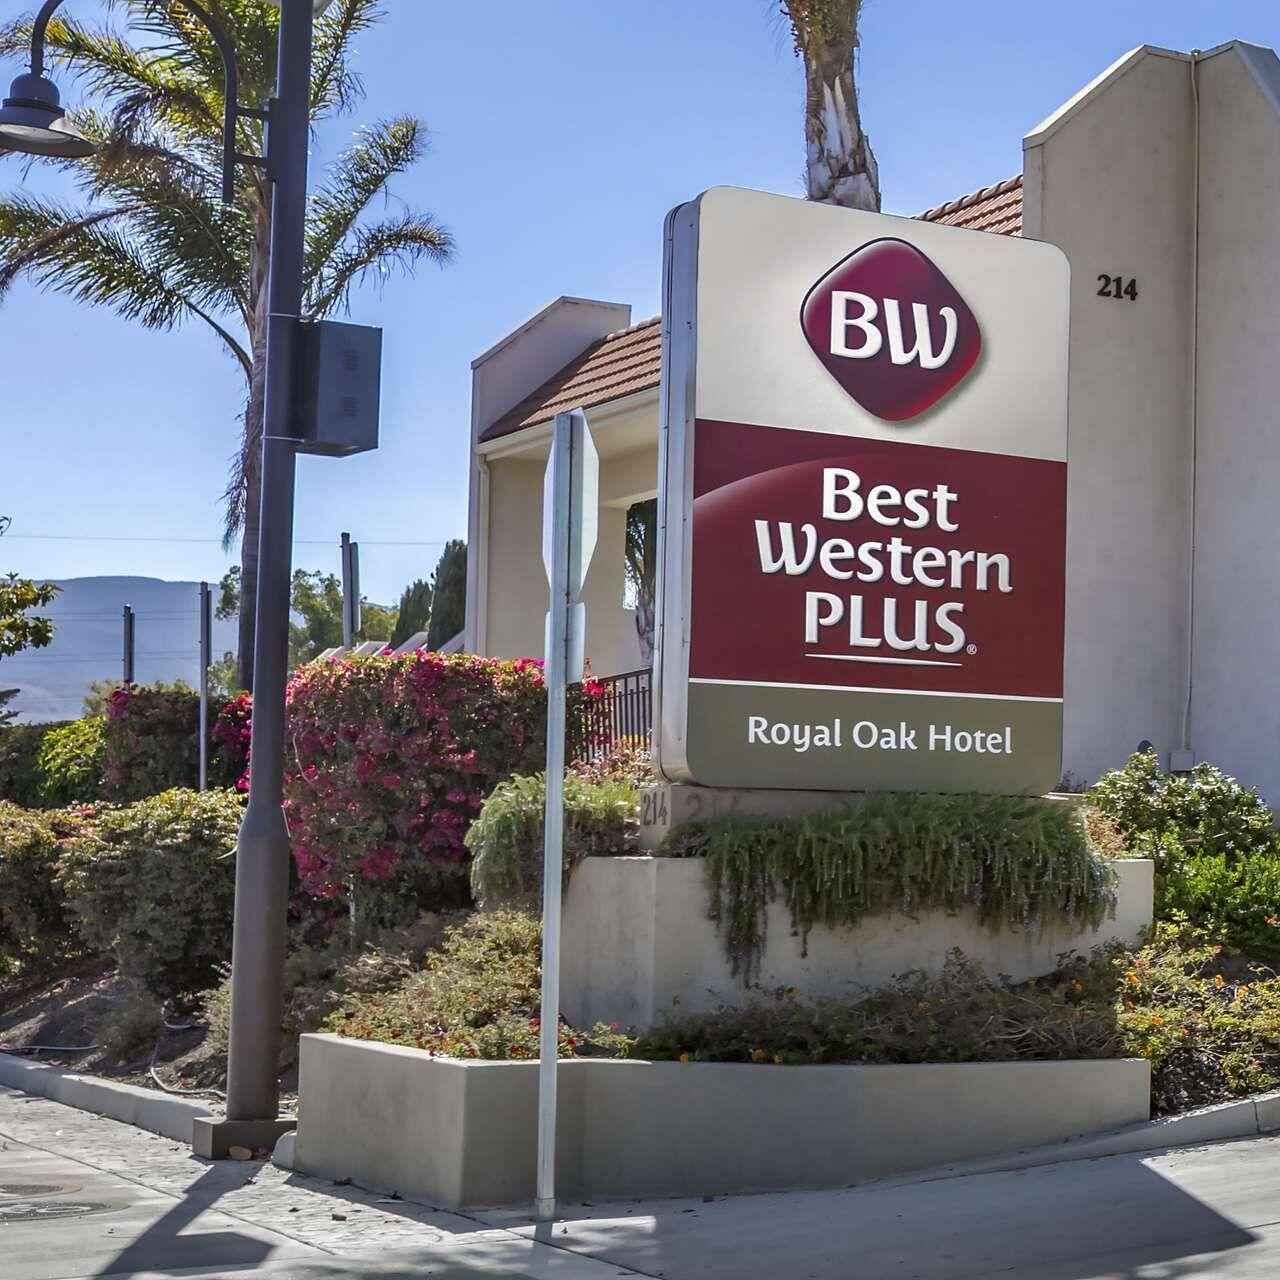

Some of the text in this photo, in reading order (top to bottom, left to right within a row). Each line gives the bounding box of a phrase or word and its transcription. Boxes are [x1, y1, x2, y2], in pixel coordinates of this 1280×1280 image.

[1096, 274, 1138, 301] 214
[829, 290, 958, 370] BW
[821, 466, 960, 533] Best
[754, 519, 1014, 594] Western
[804, 591, 968, 656] PLUS
[747, 716, 1014, 755] Royal Oak Hotel
[643, 790, 668, 826] 214
